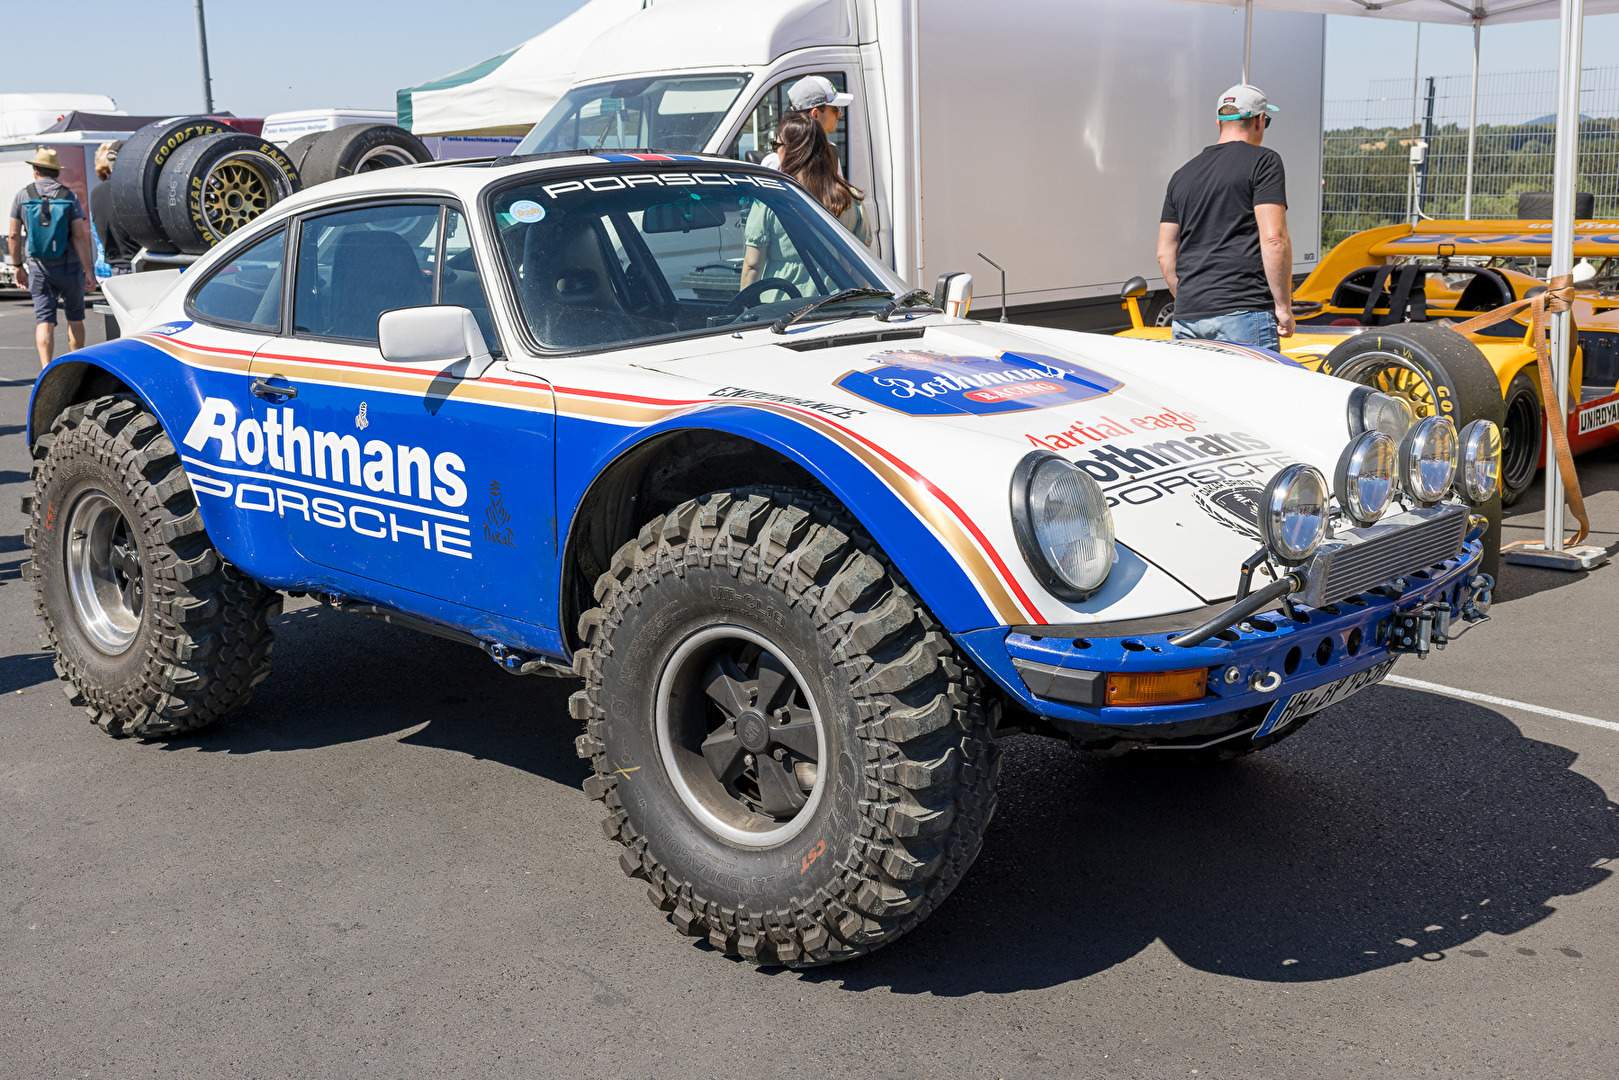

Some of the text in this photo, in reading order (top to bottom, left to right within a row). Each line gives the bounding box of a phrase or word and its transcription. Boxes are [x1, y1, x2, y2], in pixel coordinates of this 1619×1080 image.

[154, 126, 231, 165] GOODYEA
[259, 143, 298, 181] EAGLE
[542, 173, 787, 199] PORSCHE
[873, 361, 1075, 398] Rothmans
[973, 382, 1058, 401] RACING
[708, 386, 867, 420] ENDURANCE
[1130, 406, 1207, 432] eagle
[183, 396, 468, 507] Rothmans
[1073, 431, 1271, 482] othmans
[45, 501, 54, 531] CST
[184, 471, 473, 560] PORSCHE
[483, 522, 517, 549] DAKAR
[656, 826, 777, 893] LANDDRAGON
[800, 839, 826, 874] CST
